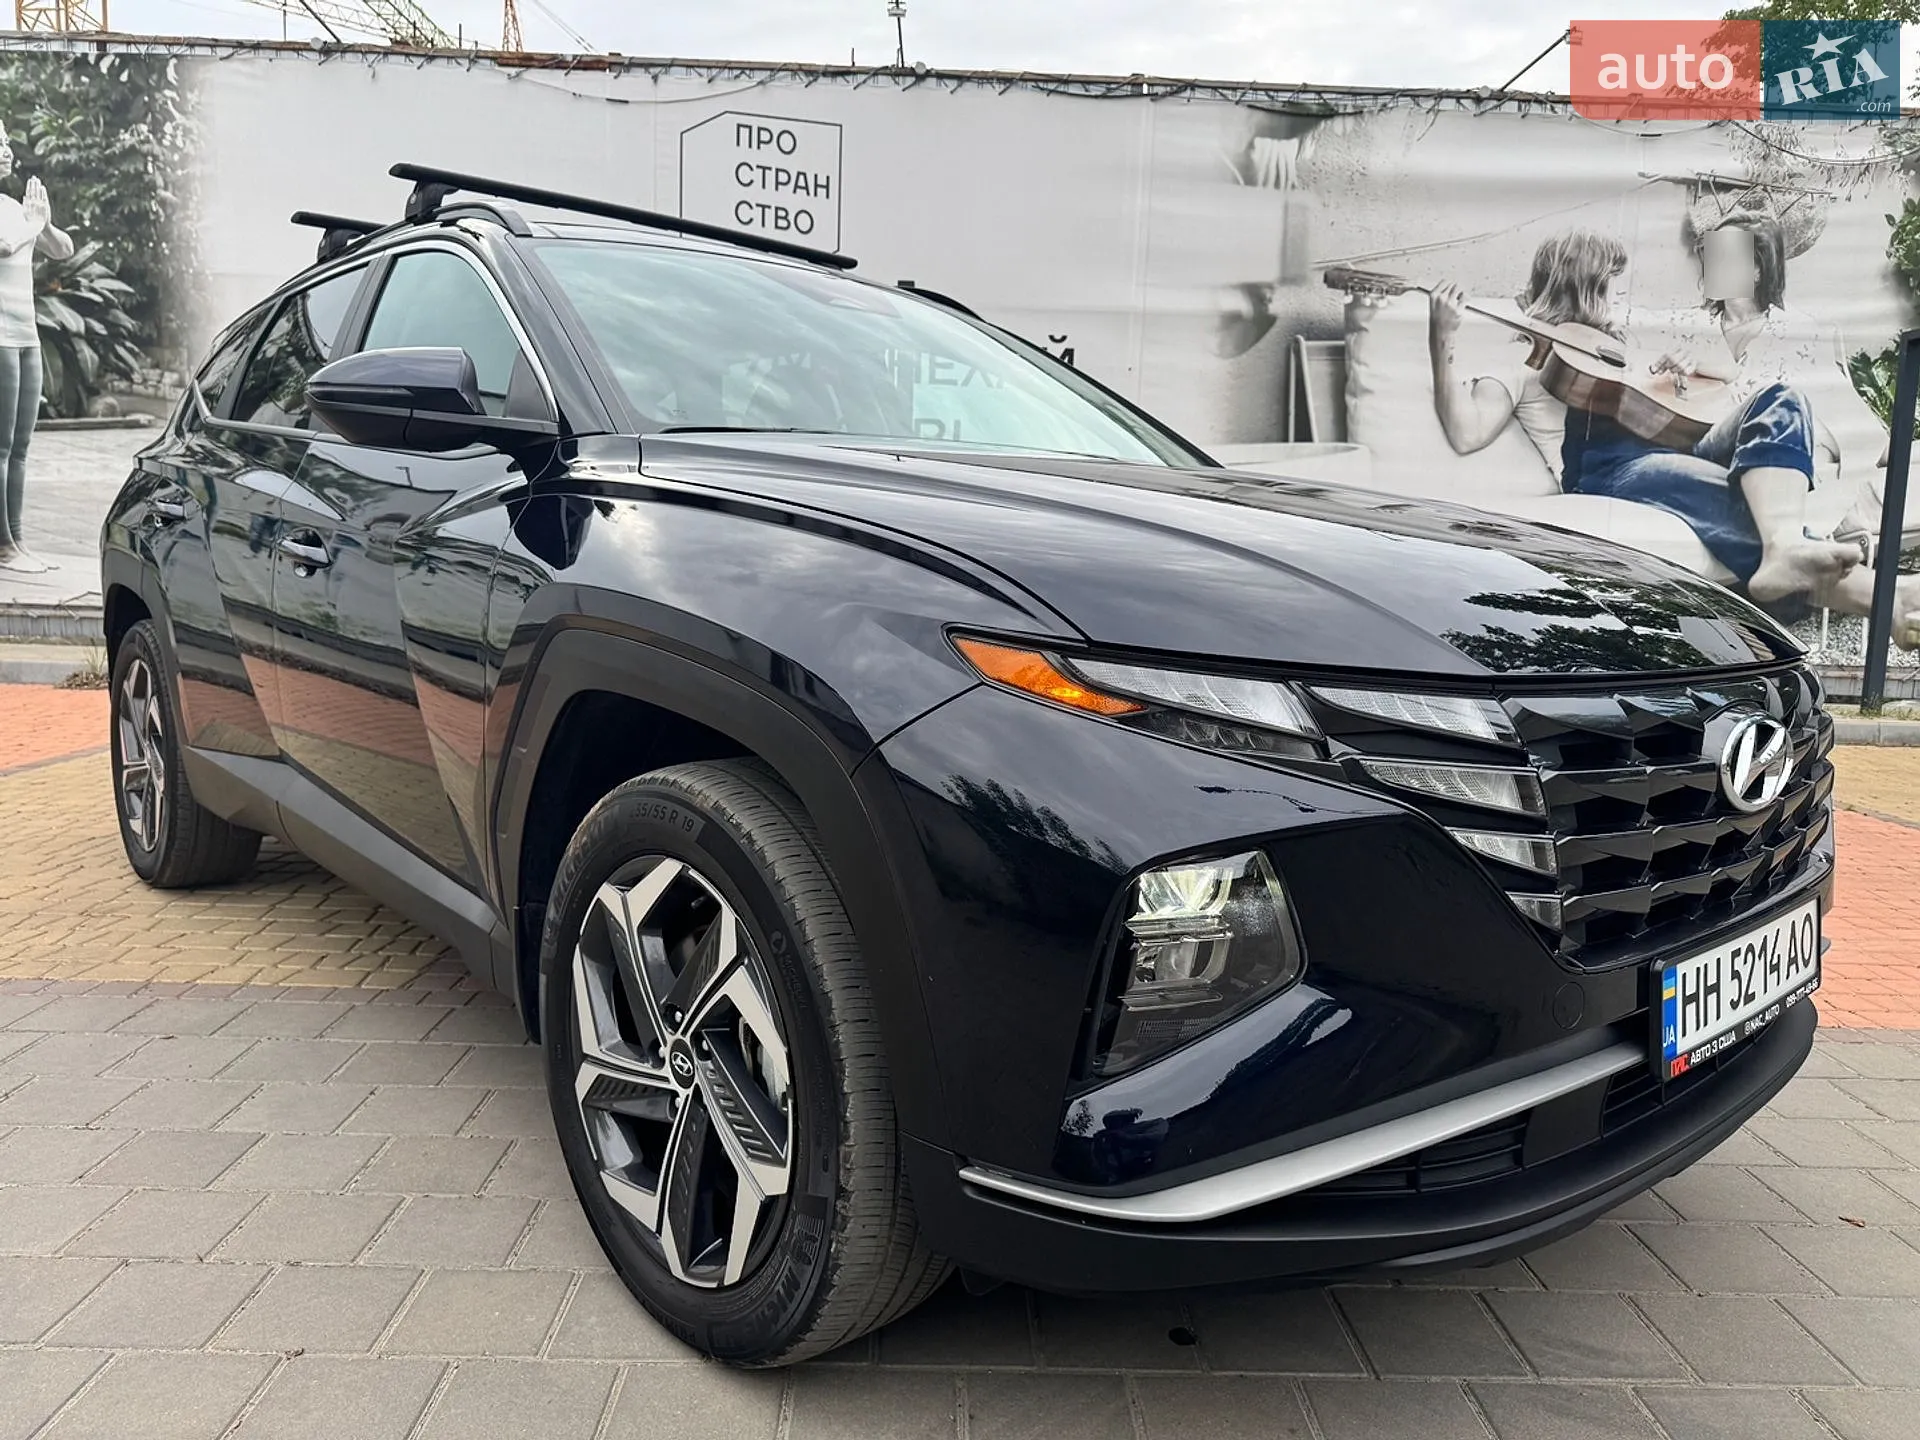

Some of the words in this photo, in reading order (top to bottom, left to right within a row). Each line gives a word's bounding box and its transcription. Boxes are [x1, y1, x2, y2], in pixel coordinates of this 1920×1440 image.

[736, 123, 797, 155] ПРО
[735, 162, 830, 199] СТРАН
[735, 200, 814, 235] СТВО
[669, 810, 678, 823] R
[681, 816, 695, 832] 19
[1681, 957, 1722, 1039] HH
[1729, 928, 1781, 1011] 5214
[1786, 912, 1814, 980] AO
